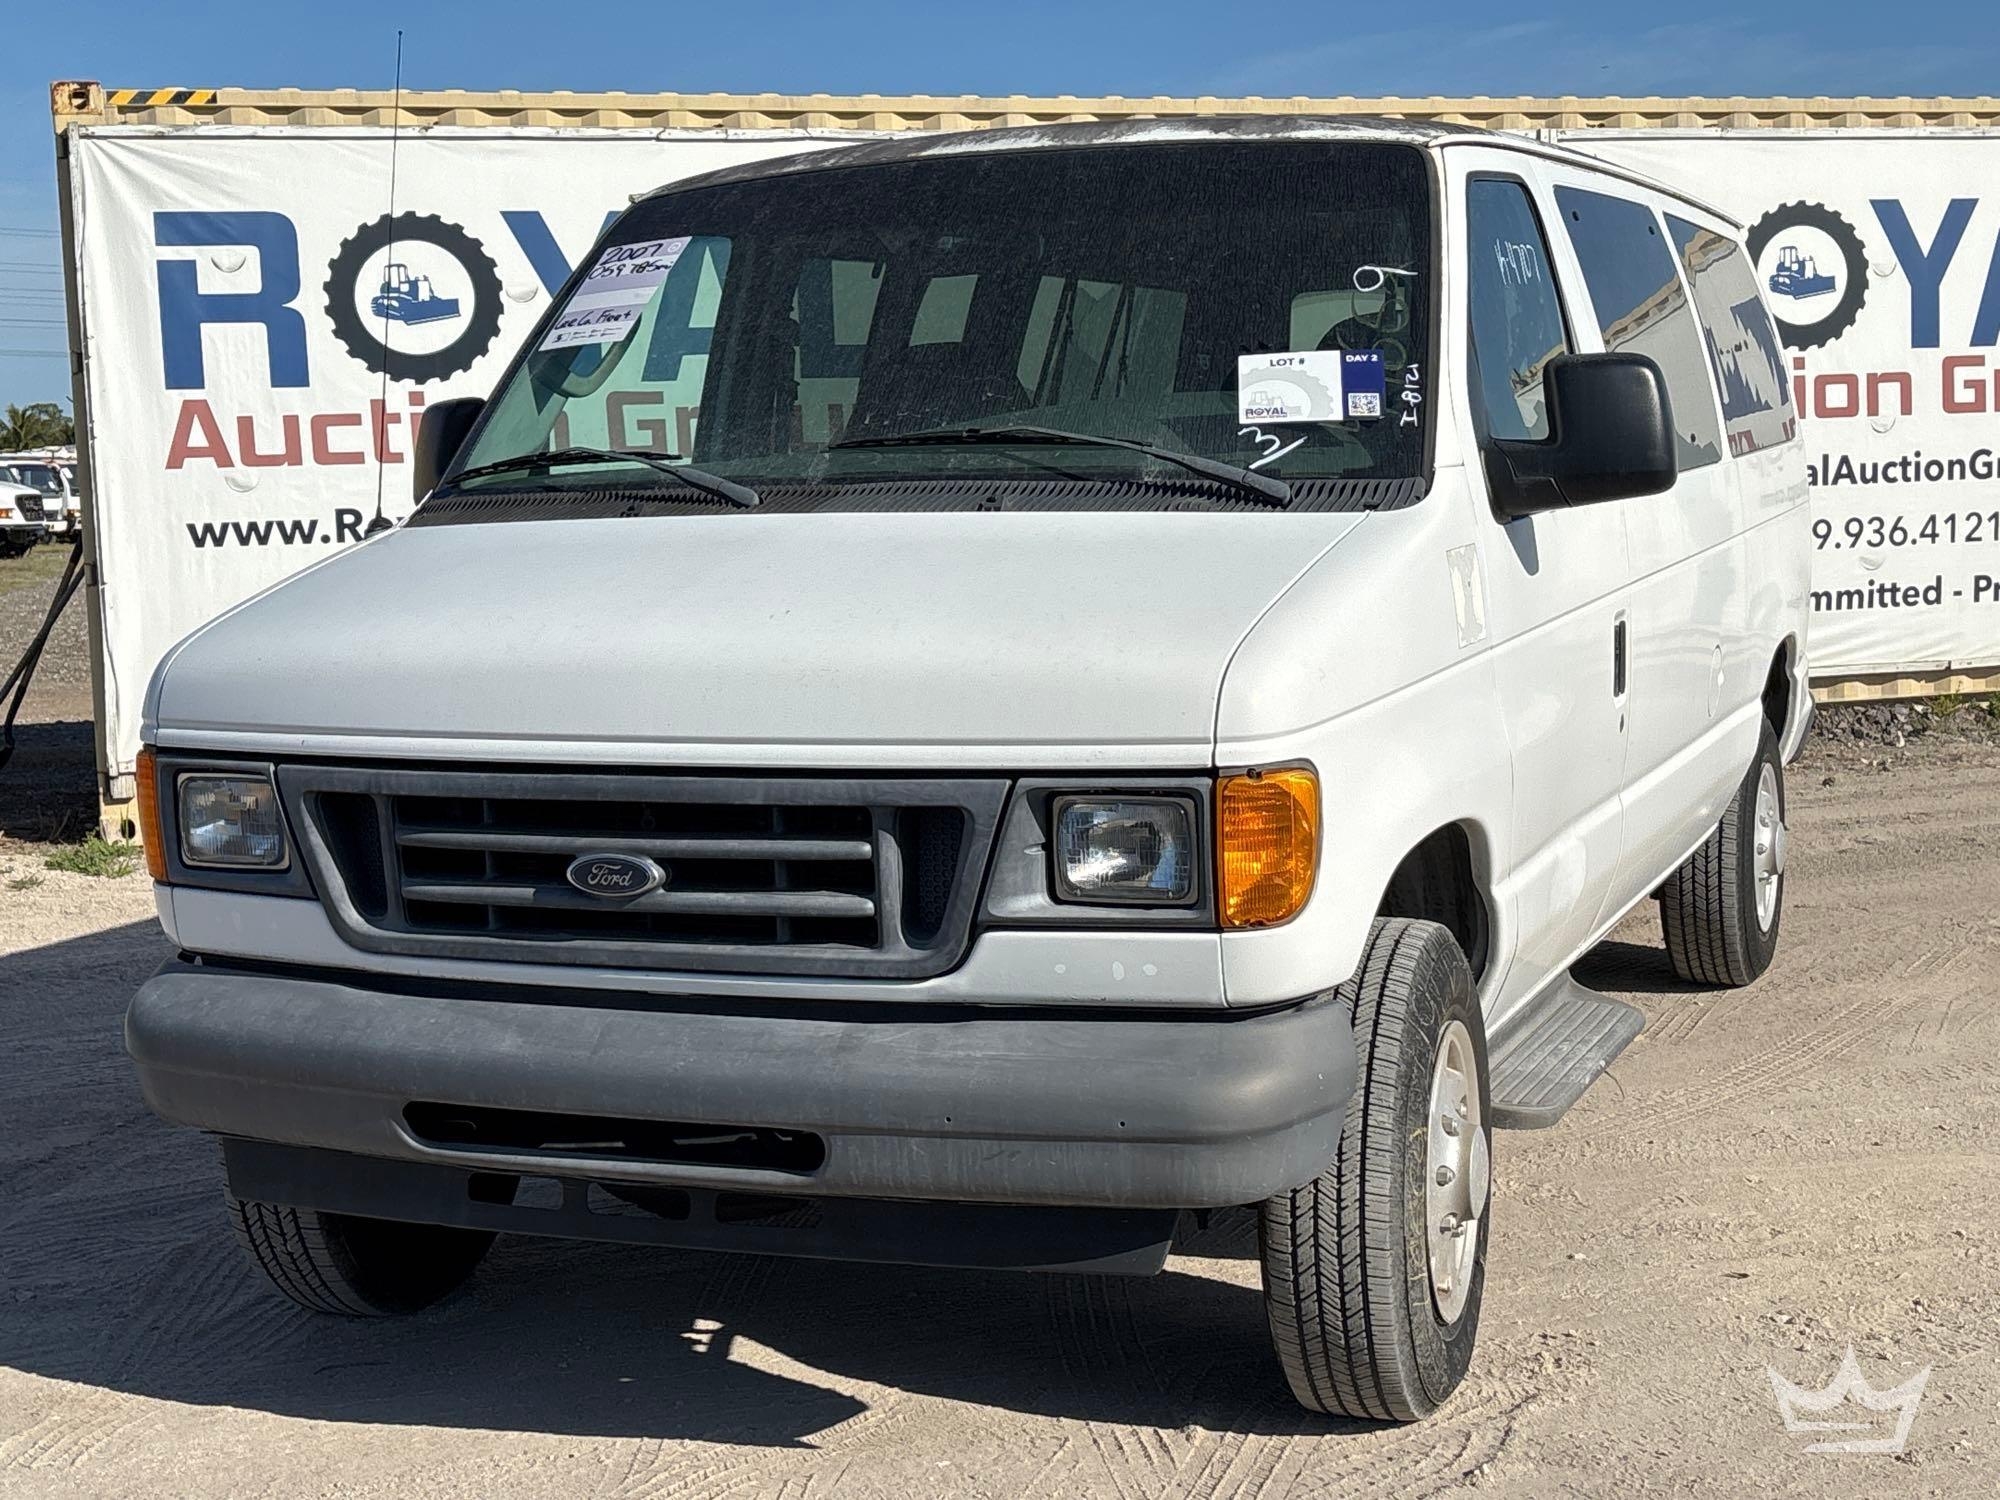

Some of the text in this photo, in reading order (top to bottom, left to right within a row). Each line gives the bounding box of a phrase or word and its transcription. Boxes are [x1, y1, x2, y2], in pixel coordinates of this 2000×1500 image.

[601, 243, 664, 266] 2007
[1269, 358, 1295, 367] LOT
[1345, 354, 1378, 363] DAY 2
[1245, 406, 1287, 417] ROYAL
[587, 863, 633, 886] Ford
